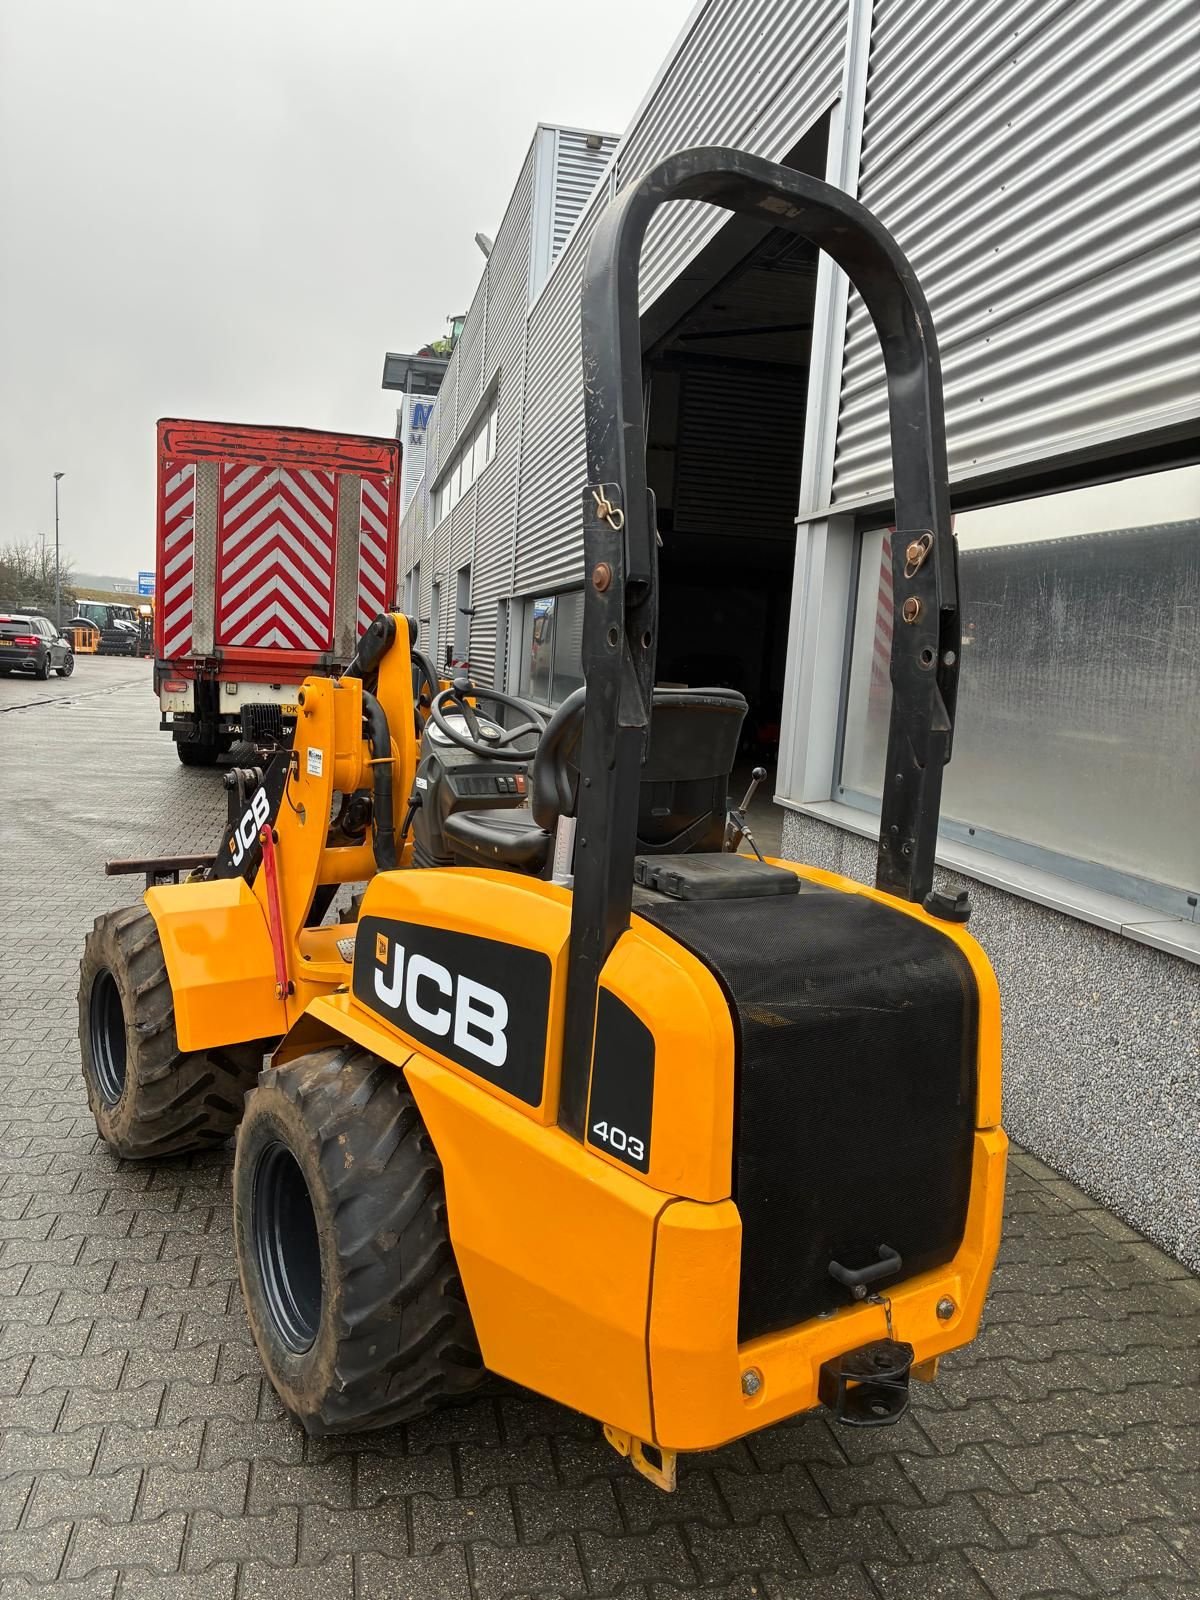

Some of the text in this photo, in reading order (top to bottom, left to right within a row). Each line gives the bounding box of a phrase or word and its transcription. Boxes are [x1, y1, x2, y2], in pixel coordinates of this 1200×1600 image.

[232, 786, 270, 867] JCB
[374, 942, 508, 1067] JCB
[593, 1120, 645, 1161] 403
